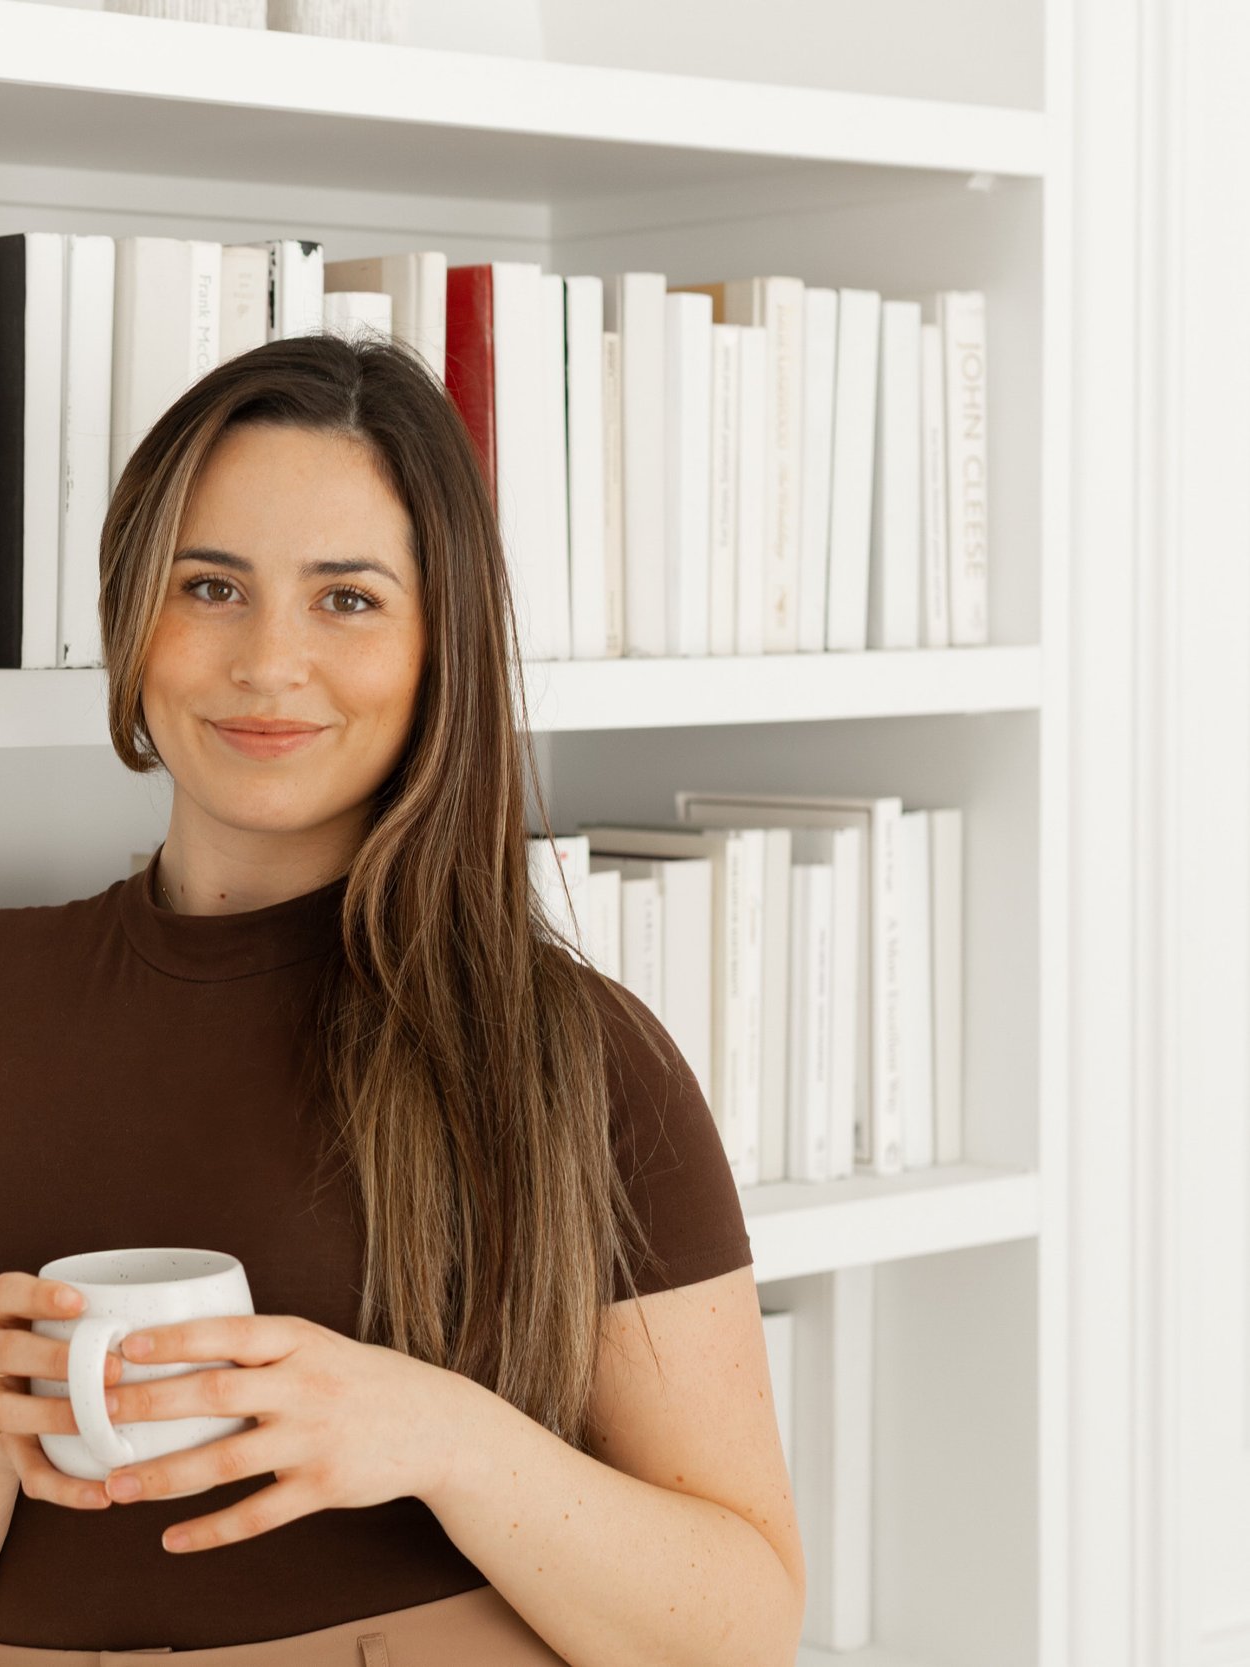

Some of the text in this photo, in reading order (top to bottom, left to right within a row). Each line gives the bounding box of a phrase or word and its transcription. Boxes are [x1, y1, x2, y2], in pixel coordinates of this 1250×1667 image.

[196, 274, 212, 376] Frank McCo
[956, 341, 988, 578] JOHN CLEESE
